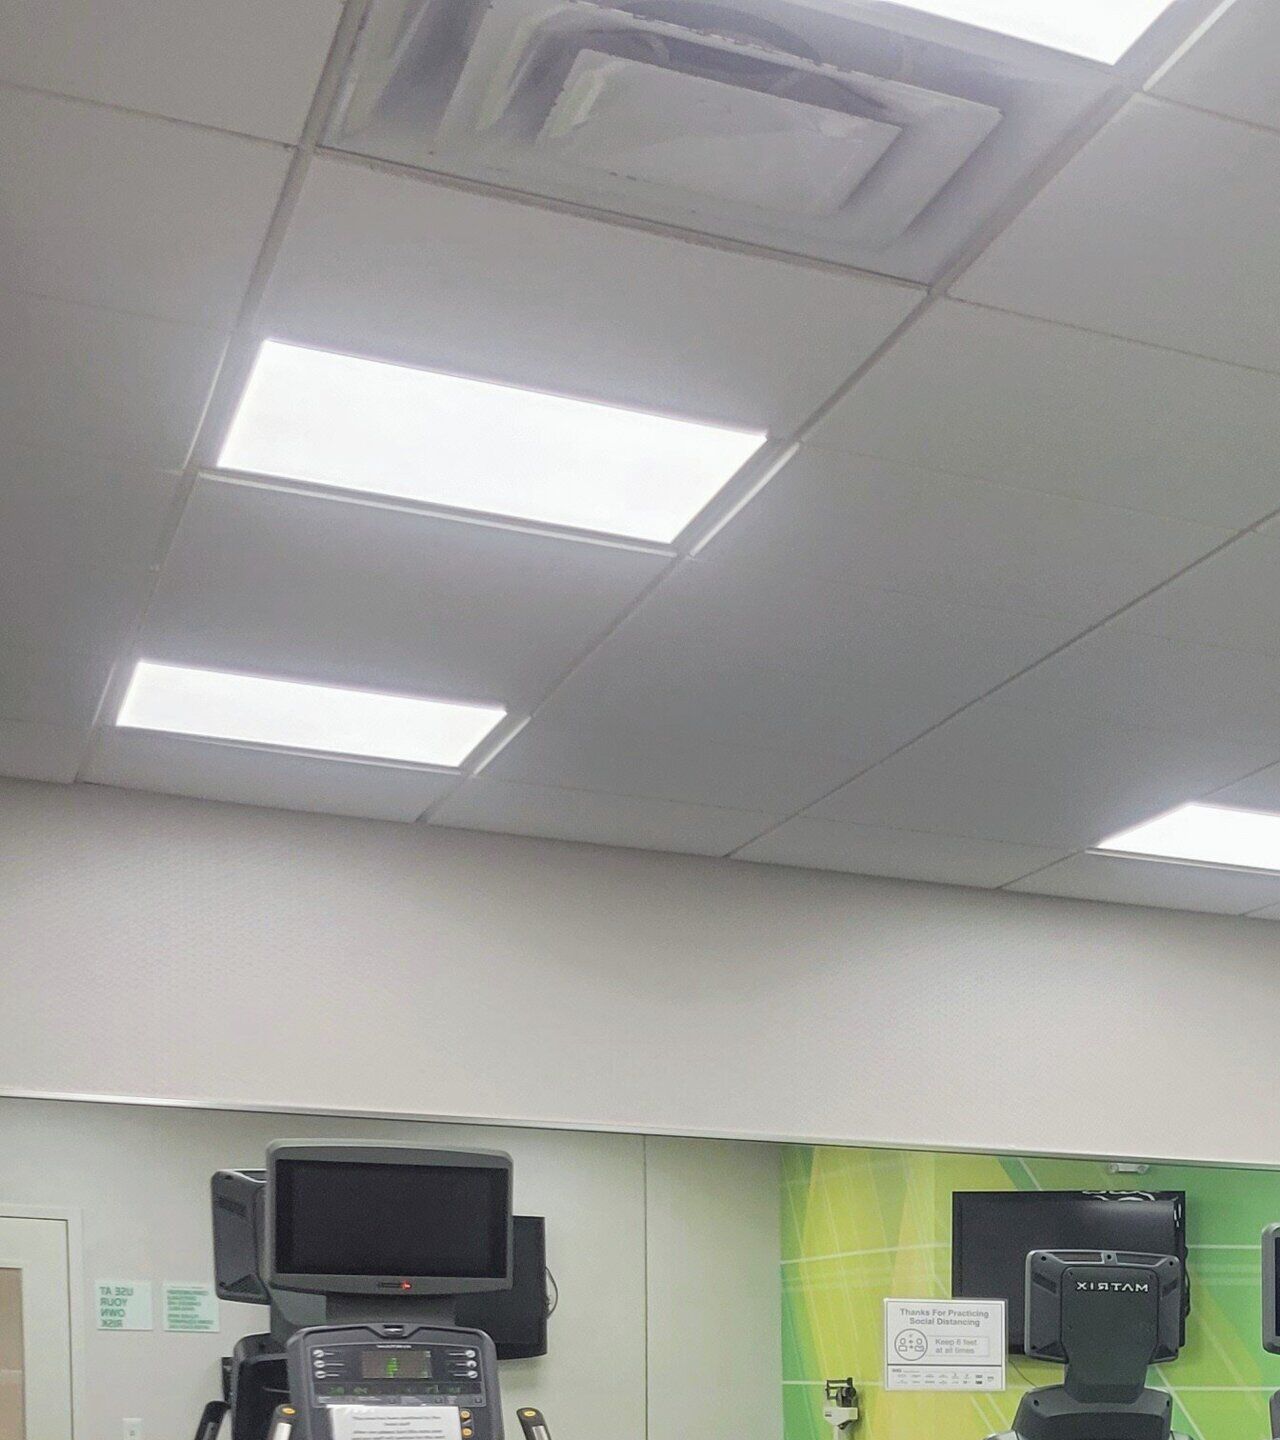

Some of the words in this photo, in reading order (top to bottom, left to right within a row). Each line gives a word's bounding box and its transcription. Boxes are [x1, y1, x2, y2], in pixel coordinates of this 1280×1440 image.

[900, 1308, 930, 1317] Thanks
[932, 1309, 946, 1317] For
[948, 1309, 990, 1319] Practicing
[909, 1317, 935, 1326] Social
[936, 1318, 981, 1328] Distancing
[935, 1339, 955, 1347] Keep
